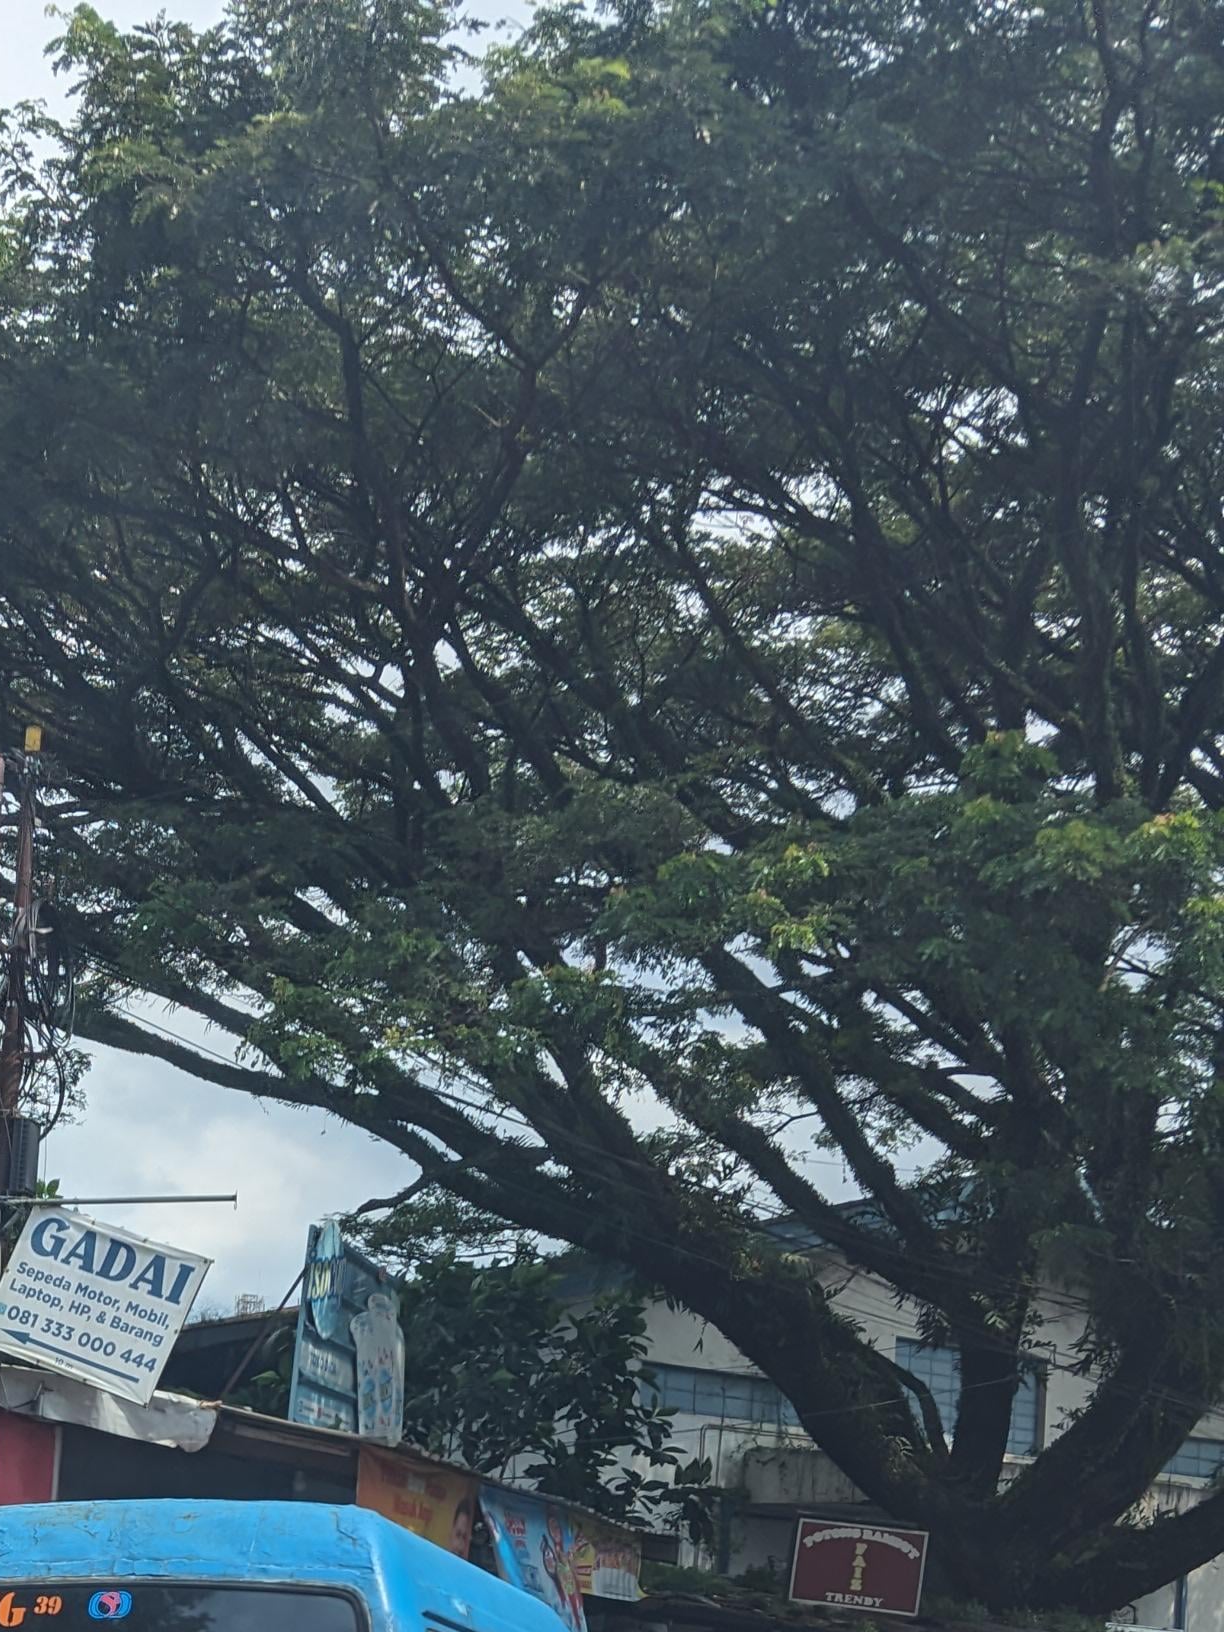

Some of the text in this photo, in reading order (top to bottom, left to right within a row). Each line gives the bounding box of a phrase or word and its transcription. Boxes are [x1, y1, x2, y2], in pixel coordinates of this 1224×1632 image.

[30, 1217, 196, 1305] GADAI
[9, 1278, 164, 1347] Laptop, HP, & Barang
[16, 1261, 170, 1330] Sepeda Motor, Mobil,
[7, 1306, 158, 1372] 081 333 000 444
[33, 1595, 63, 1615] 39
[825, 1592, 884, 1607] TRENDY
